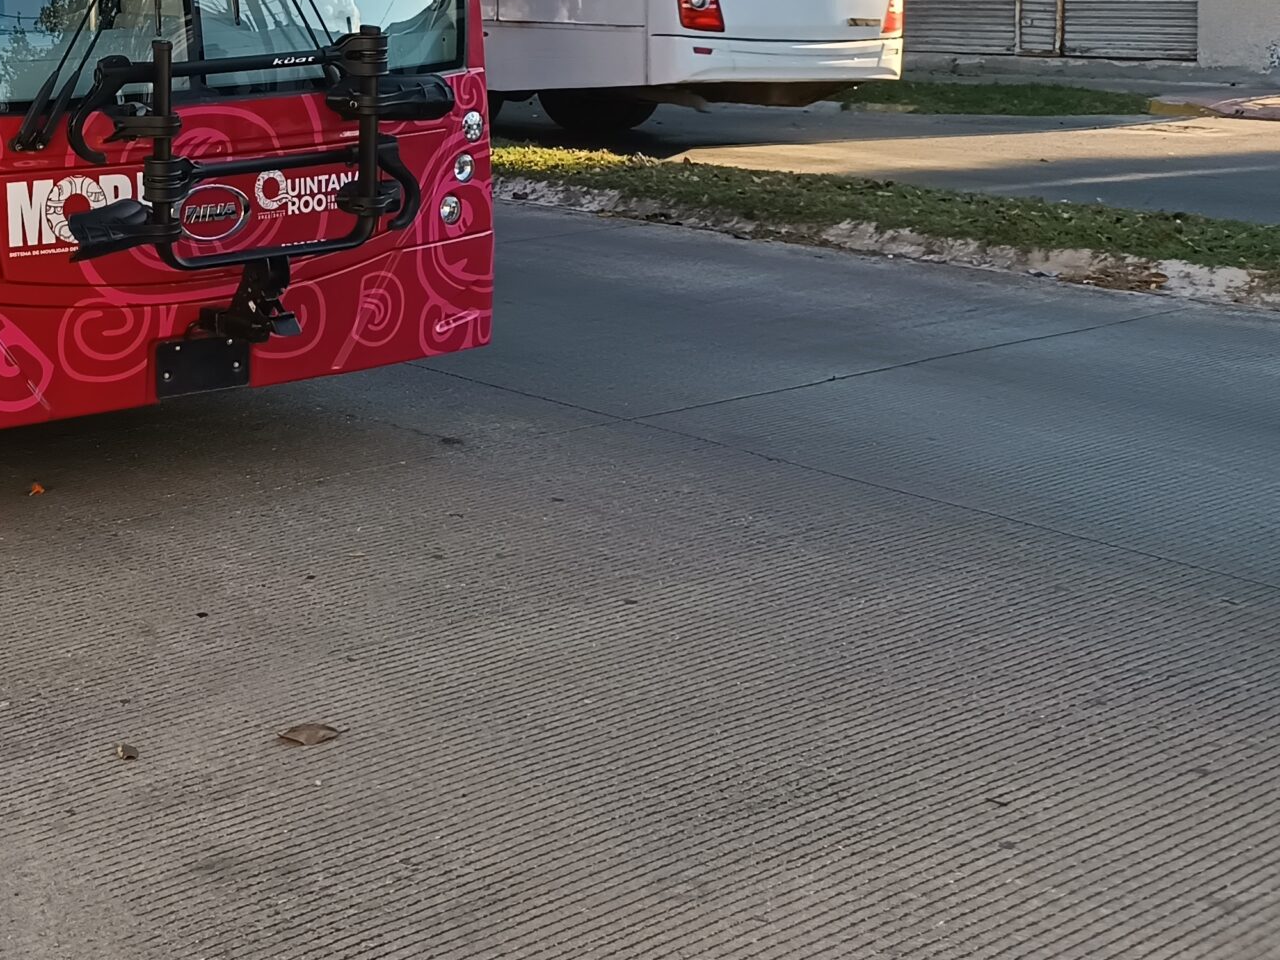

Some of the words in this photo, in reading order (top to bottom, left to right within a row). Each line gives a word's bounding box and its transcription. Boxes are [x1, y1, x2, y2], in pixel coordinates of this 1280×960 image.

[287, 193, 327, 216] ROO
[9, 250, 32, 258] SISTEMA
[40, 247, 69, 255] MOVILIDAD
